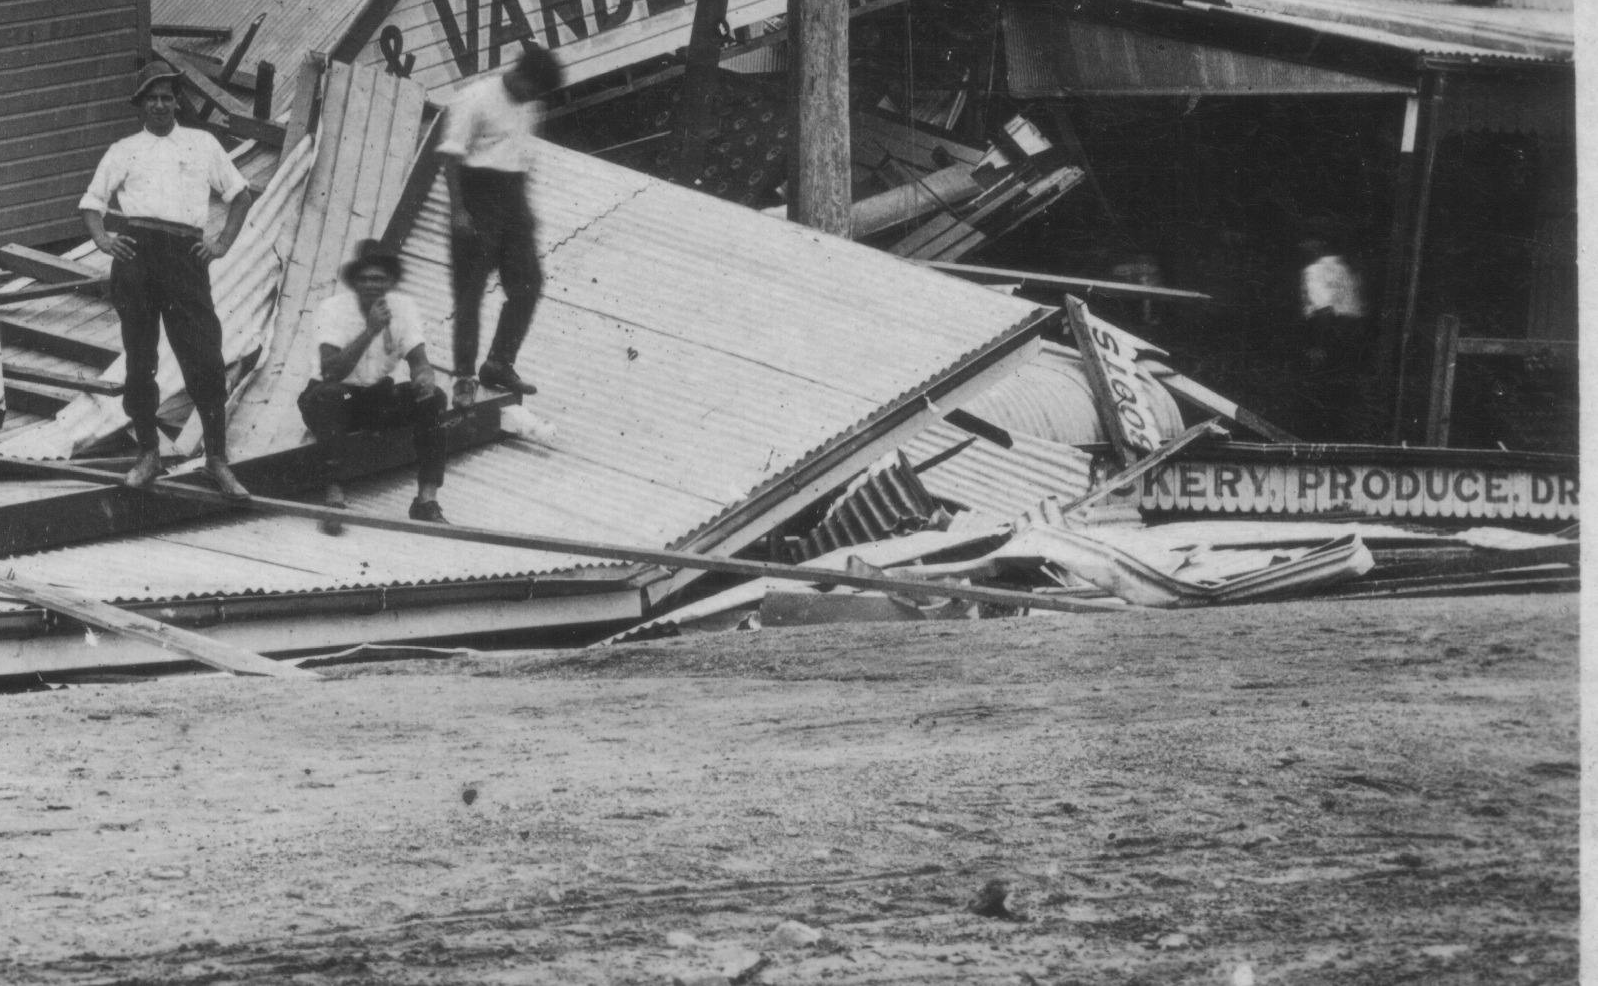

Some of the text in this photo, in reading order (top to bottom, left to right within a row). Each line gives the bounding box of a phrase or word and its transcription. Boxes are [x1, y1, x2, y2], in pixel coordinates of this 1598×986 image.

[378, 24, 416, 80] &
[1110, 464, 1276, 499] KERY,
[1531, 473, 1580, 505] DR
